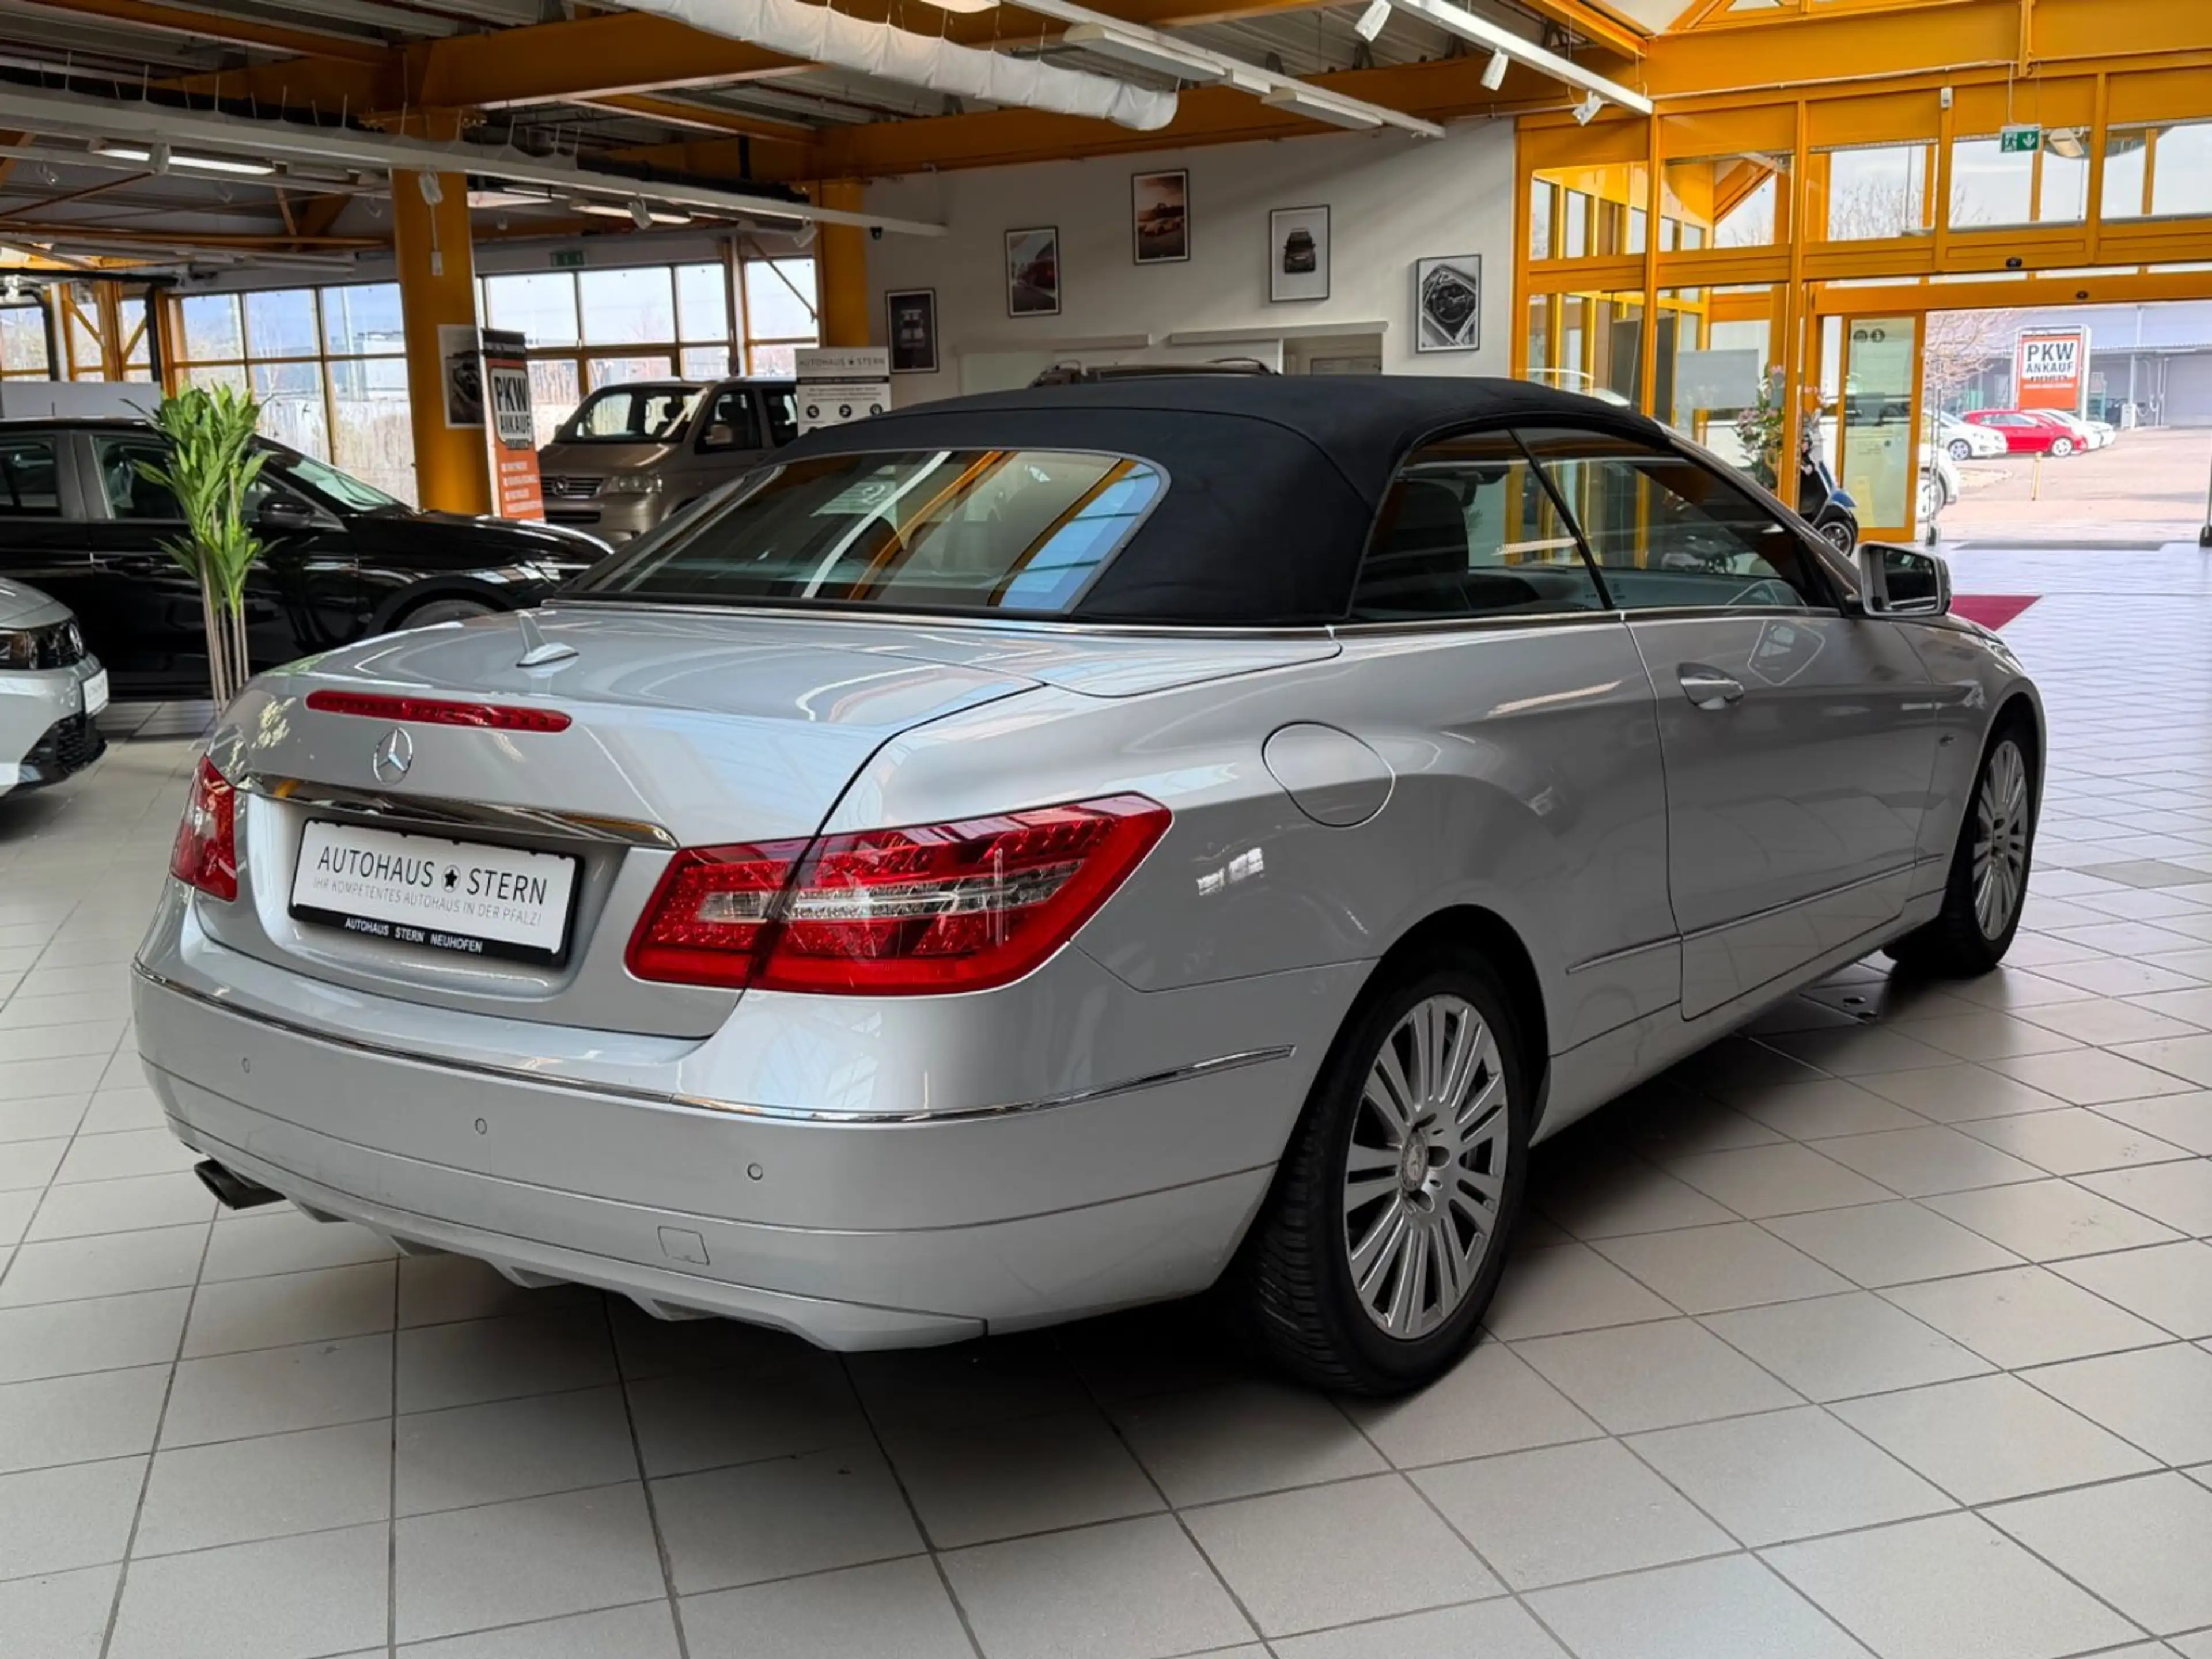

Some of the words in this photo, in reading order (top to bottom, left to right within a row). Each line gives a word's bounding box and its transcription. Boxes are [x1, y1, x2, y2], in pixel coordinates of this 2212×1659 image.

[2026, 362, 2074, 373] ANKAUF
[2027, 342, 2074, 362] PKW
[494, 376, 527, 412] PKW
[317, 846, 435, 888] AUTOHAUS
[467, 867, 548, 906] STERN
[313, 876, 329, 889] IHR
[331, 880, 402, 904] KOMPETENTES
[403, 892, 460, 913] AUTOHAUS
[463, 902, 475, 915] IN
[477, 903, 500, 919] DER
[344, 917, 389, 936] AUTOHAUS
[394, 926, 425, 943] STERN
[430, 933, 483, 953] NEUHOFEN
